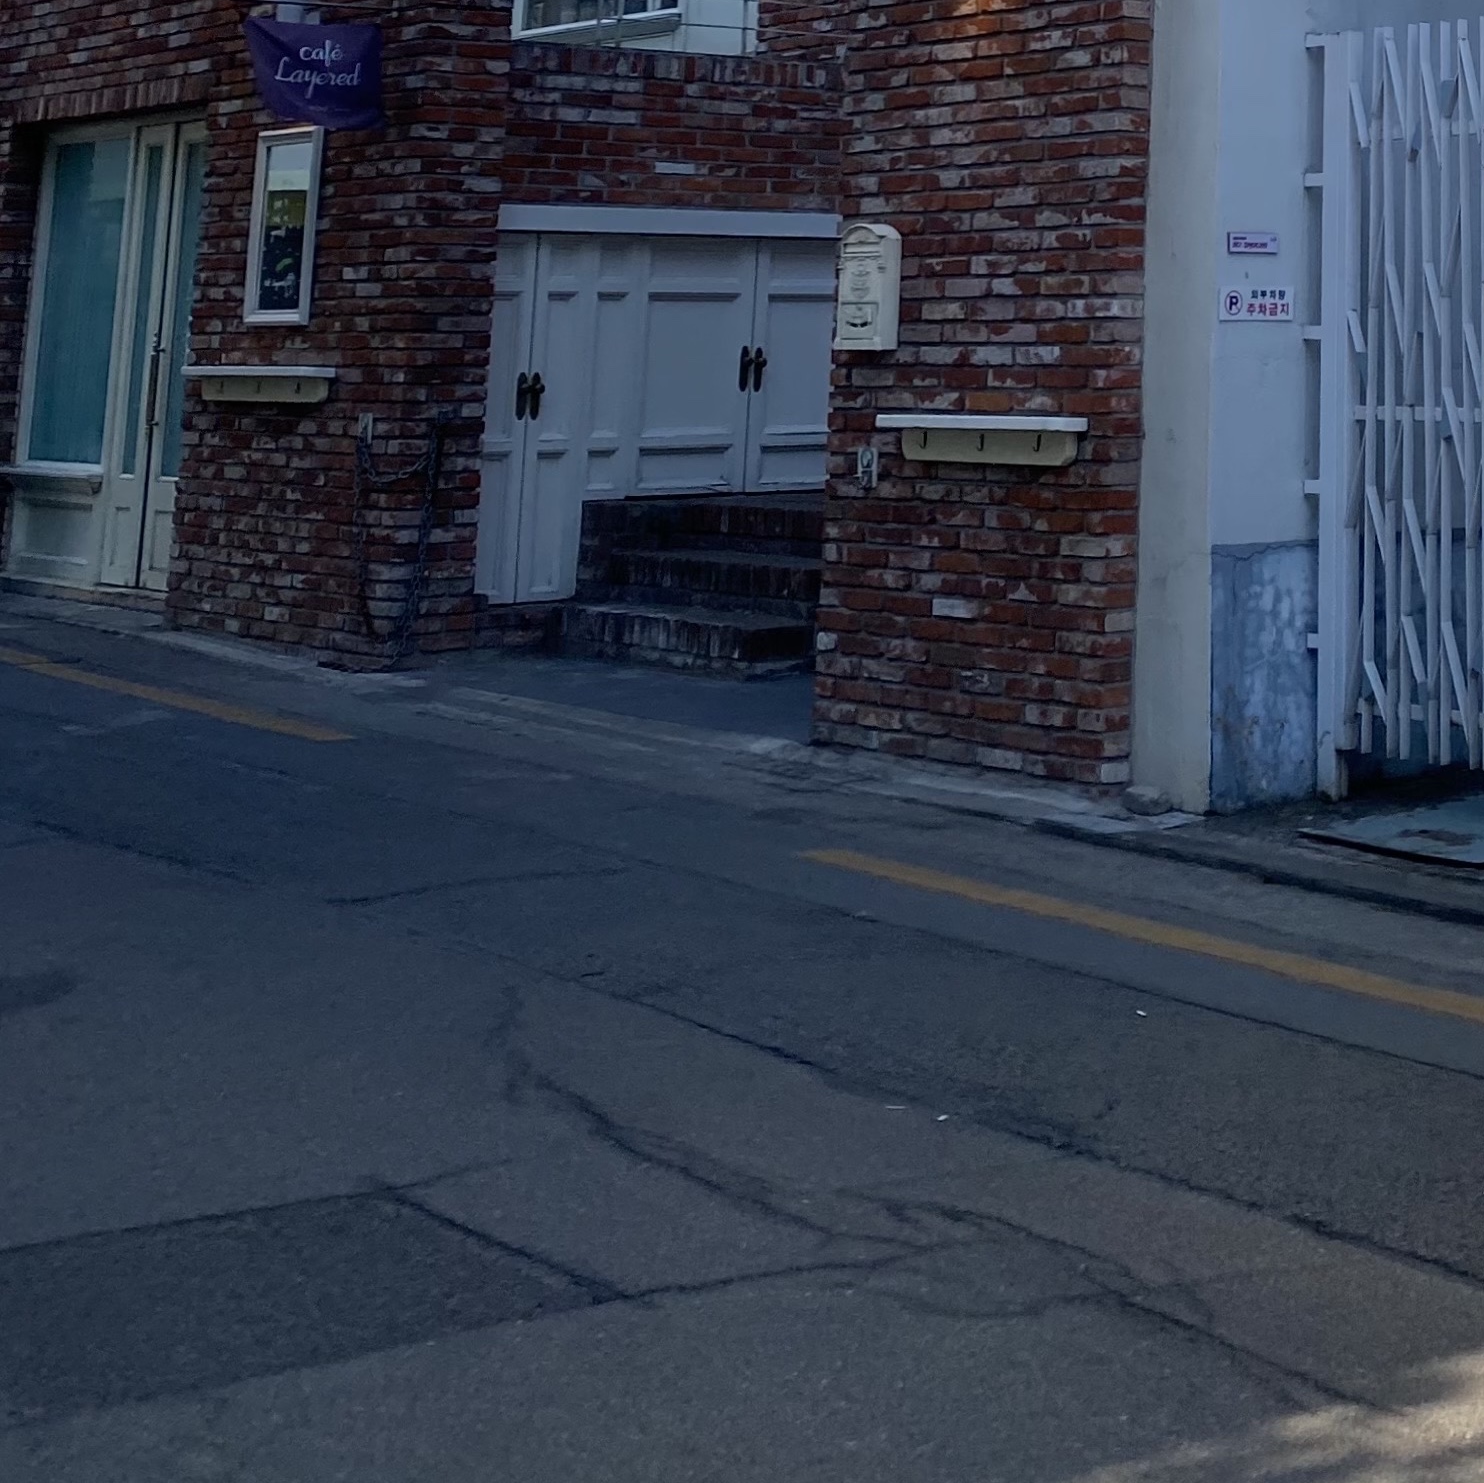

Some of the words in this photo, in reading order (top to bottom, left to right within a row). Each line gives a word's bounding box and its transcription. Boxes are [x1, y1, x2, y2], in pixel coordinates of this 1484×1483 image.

[299, 40, 342, 67] café
[274, 56, 361, 99] Layered
[1246, 302, 1290, 317] 주차금지
